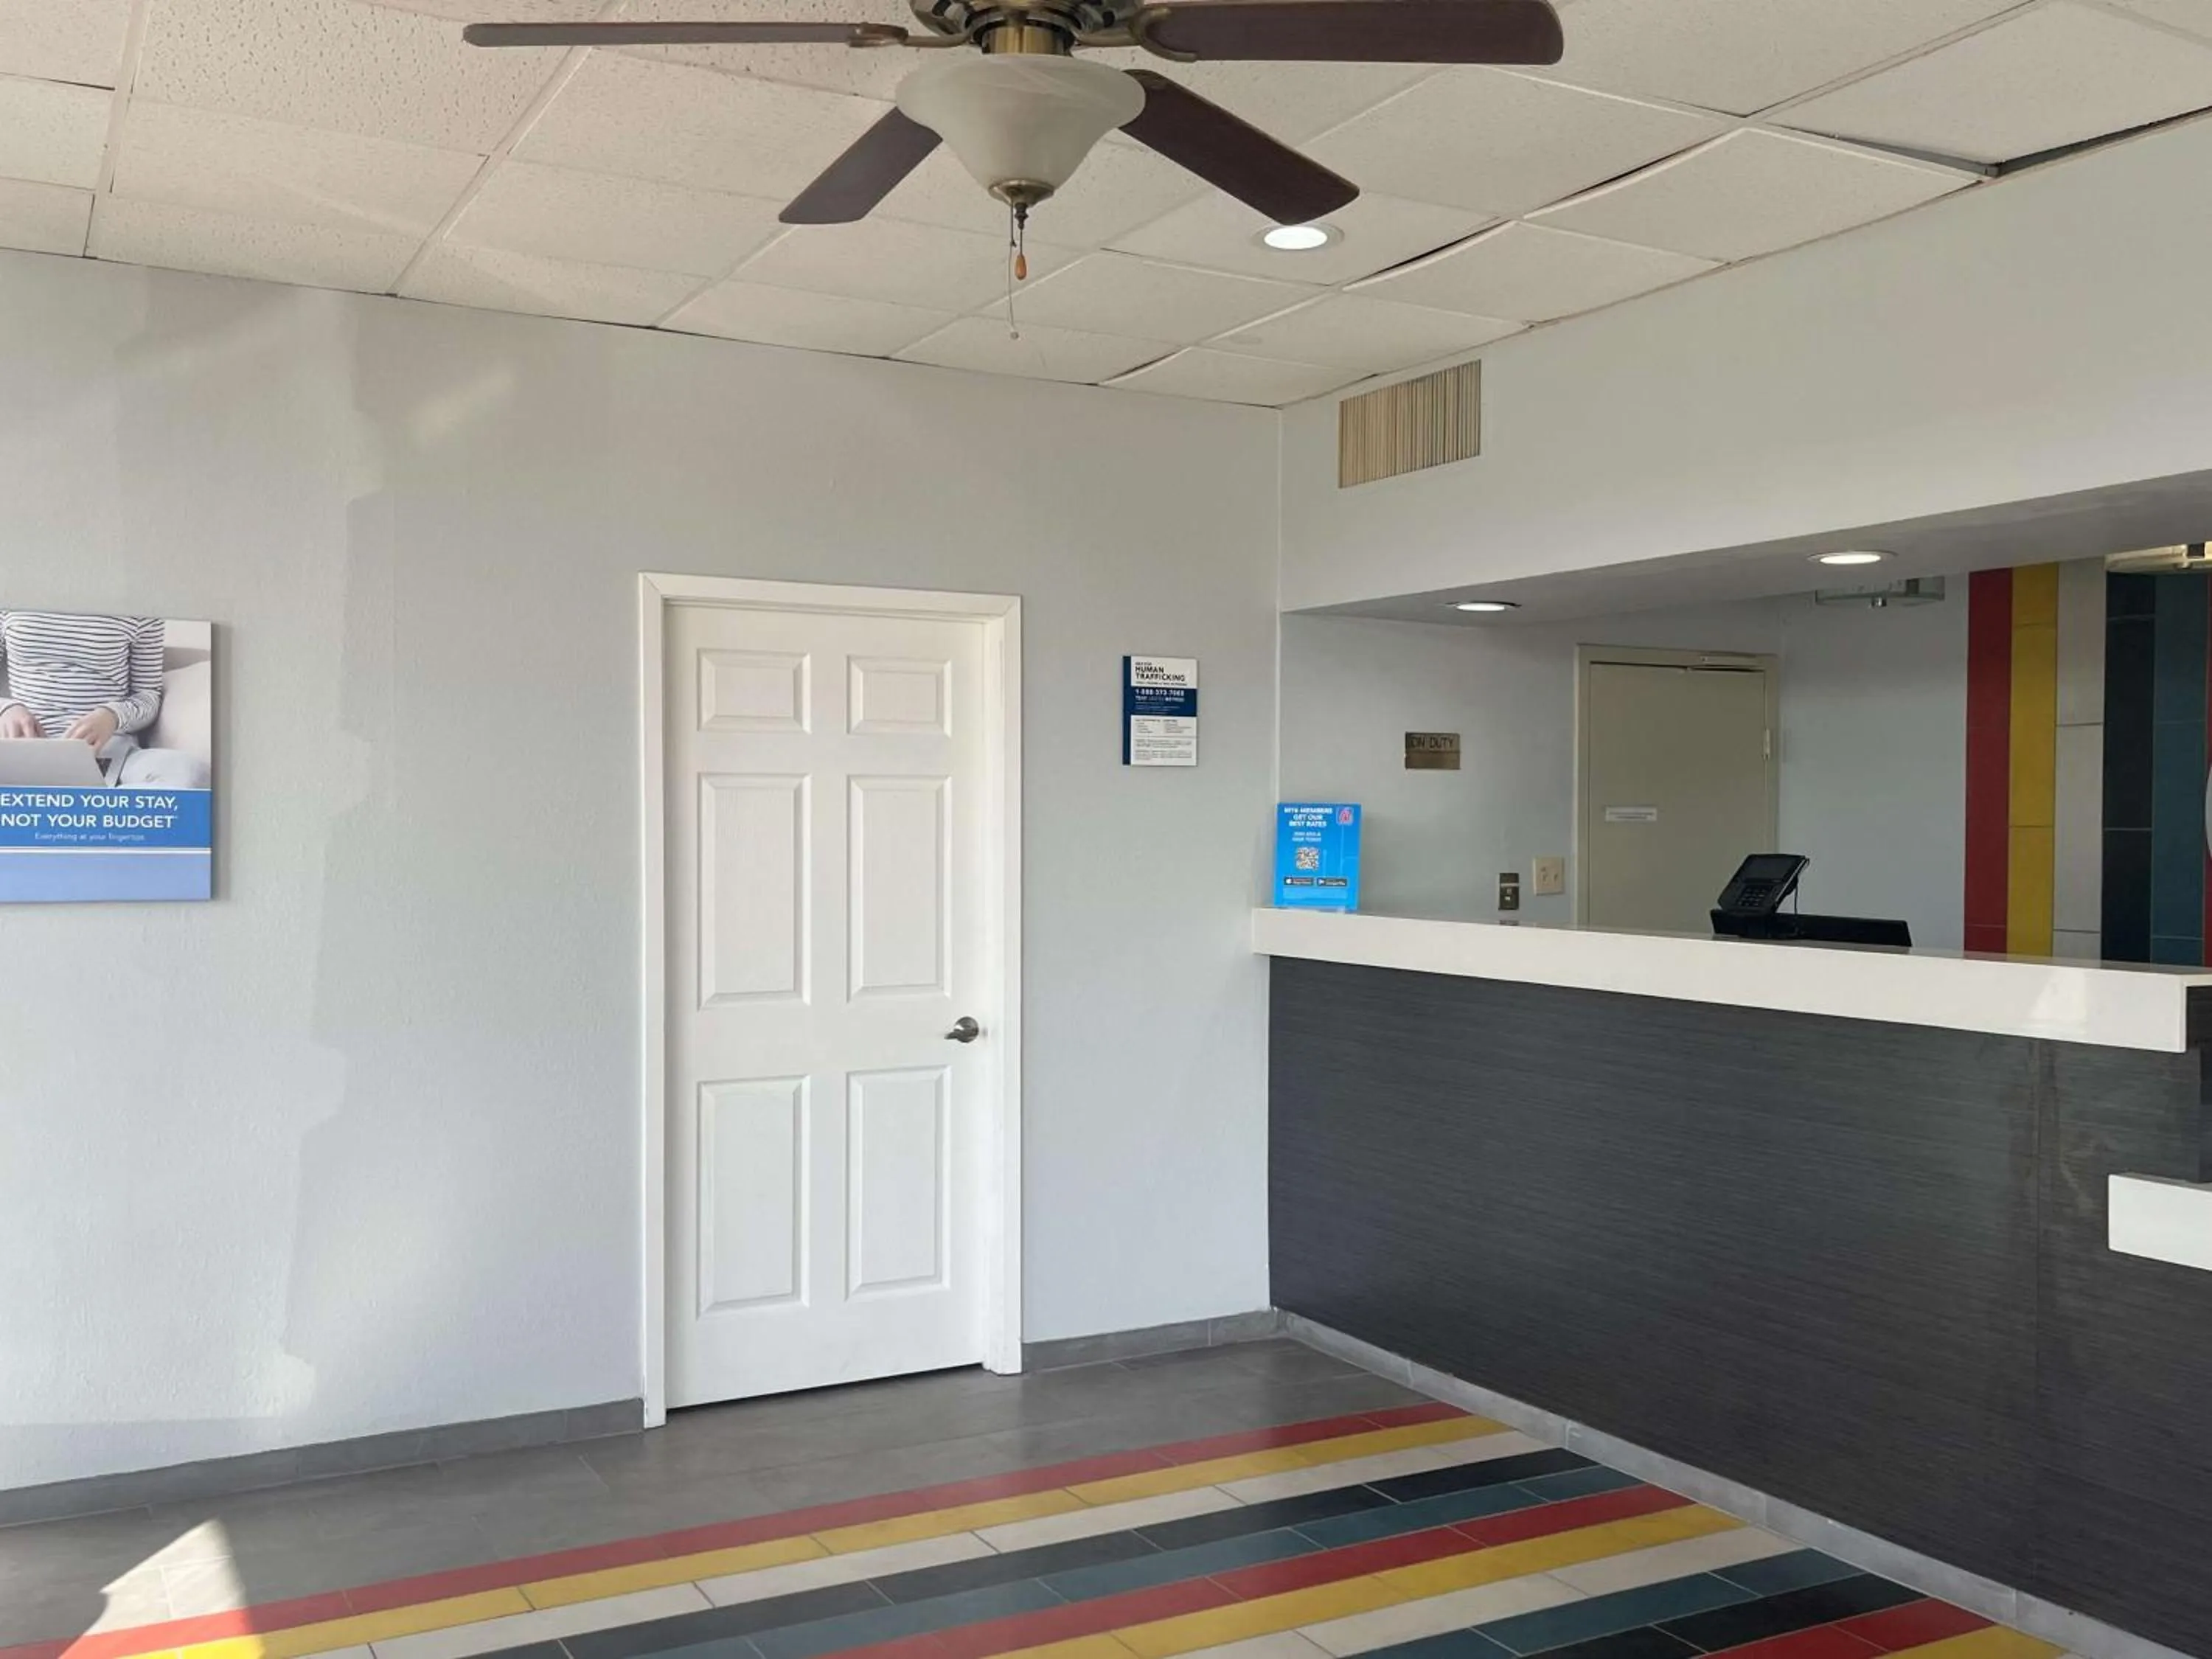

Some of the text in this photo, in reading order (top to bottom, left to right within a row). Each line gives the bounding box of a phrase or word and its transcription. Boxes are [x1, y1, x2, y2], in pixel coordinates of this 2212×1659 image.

[1429, 737, 1453, 748] DUTY
[1, 793, 178, 811] EXTEND YOUR STAY,
[1, 814, 41, 827] NOT
[47, 814, 97, 827] YOUR
